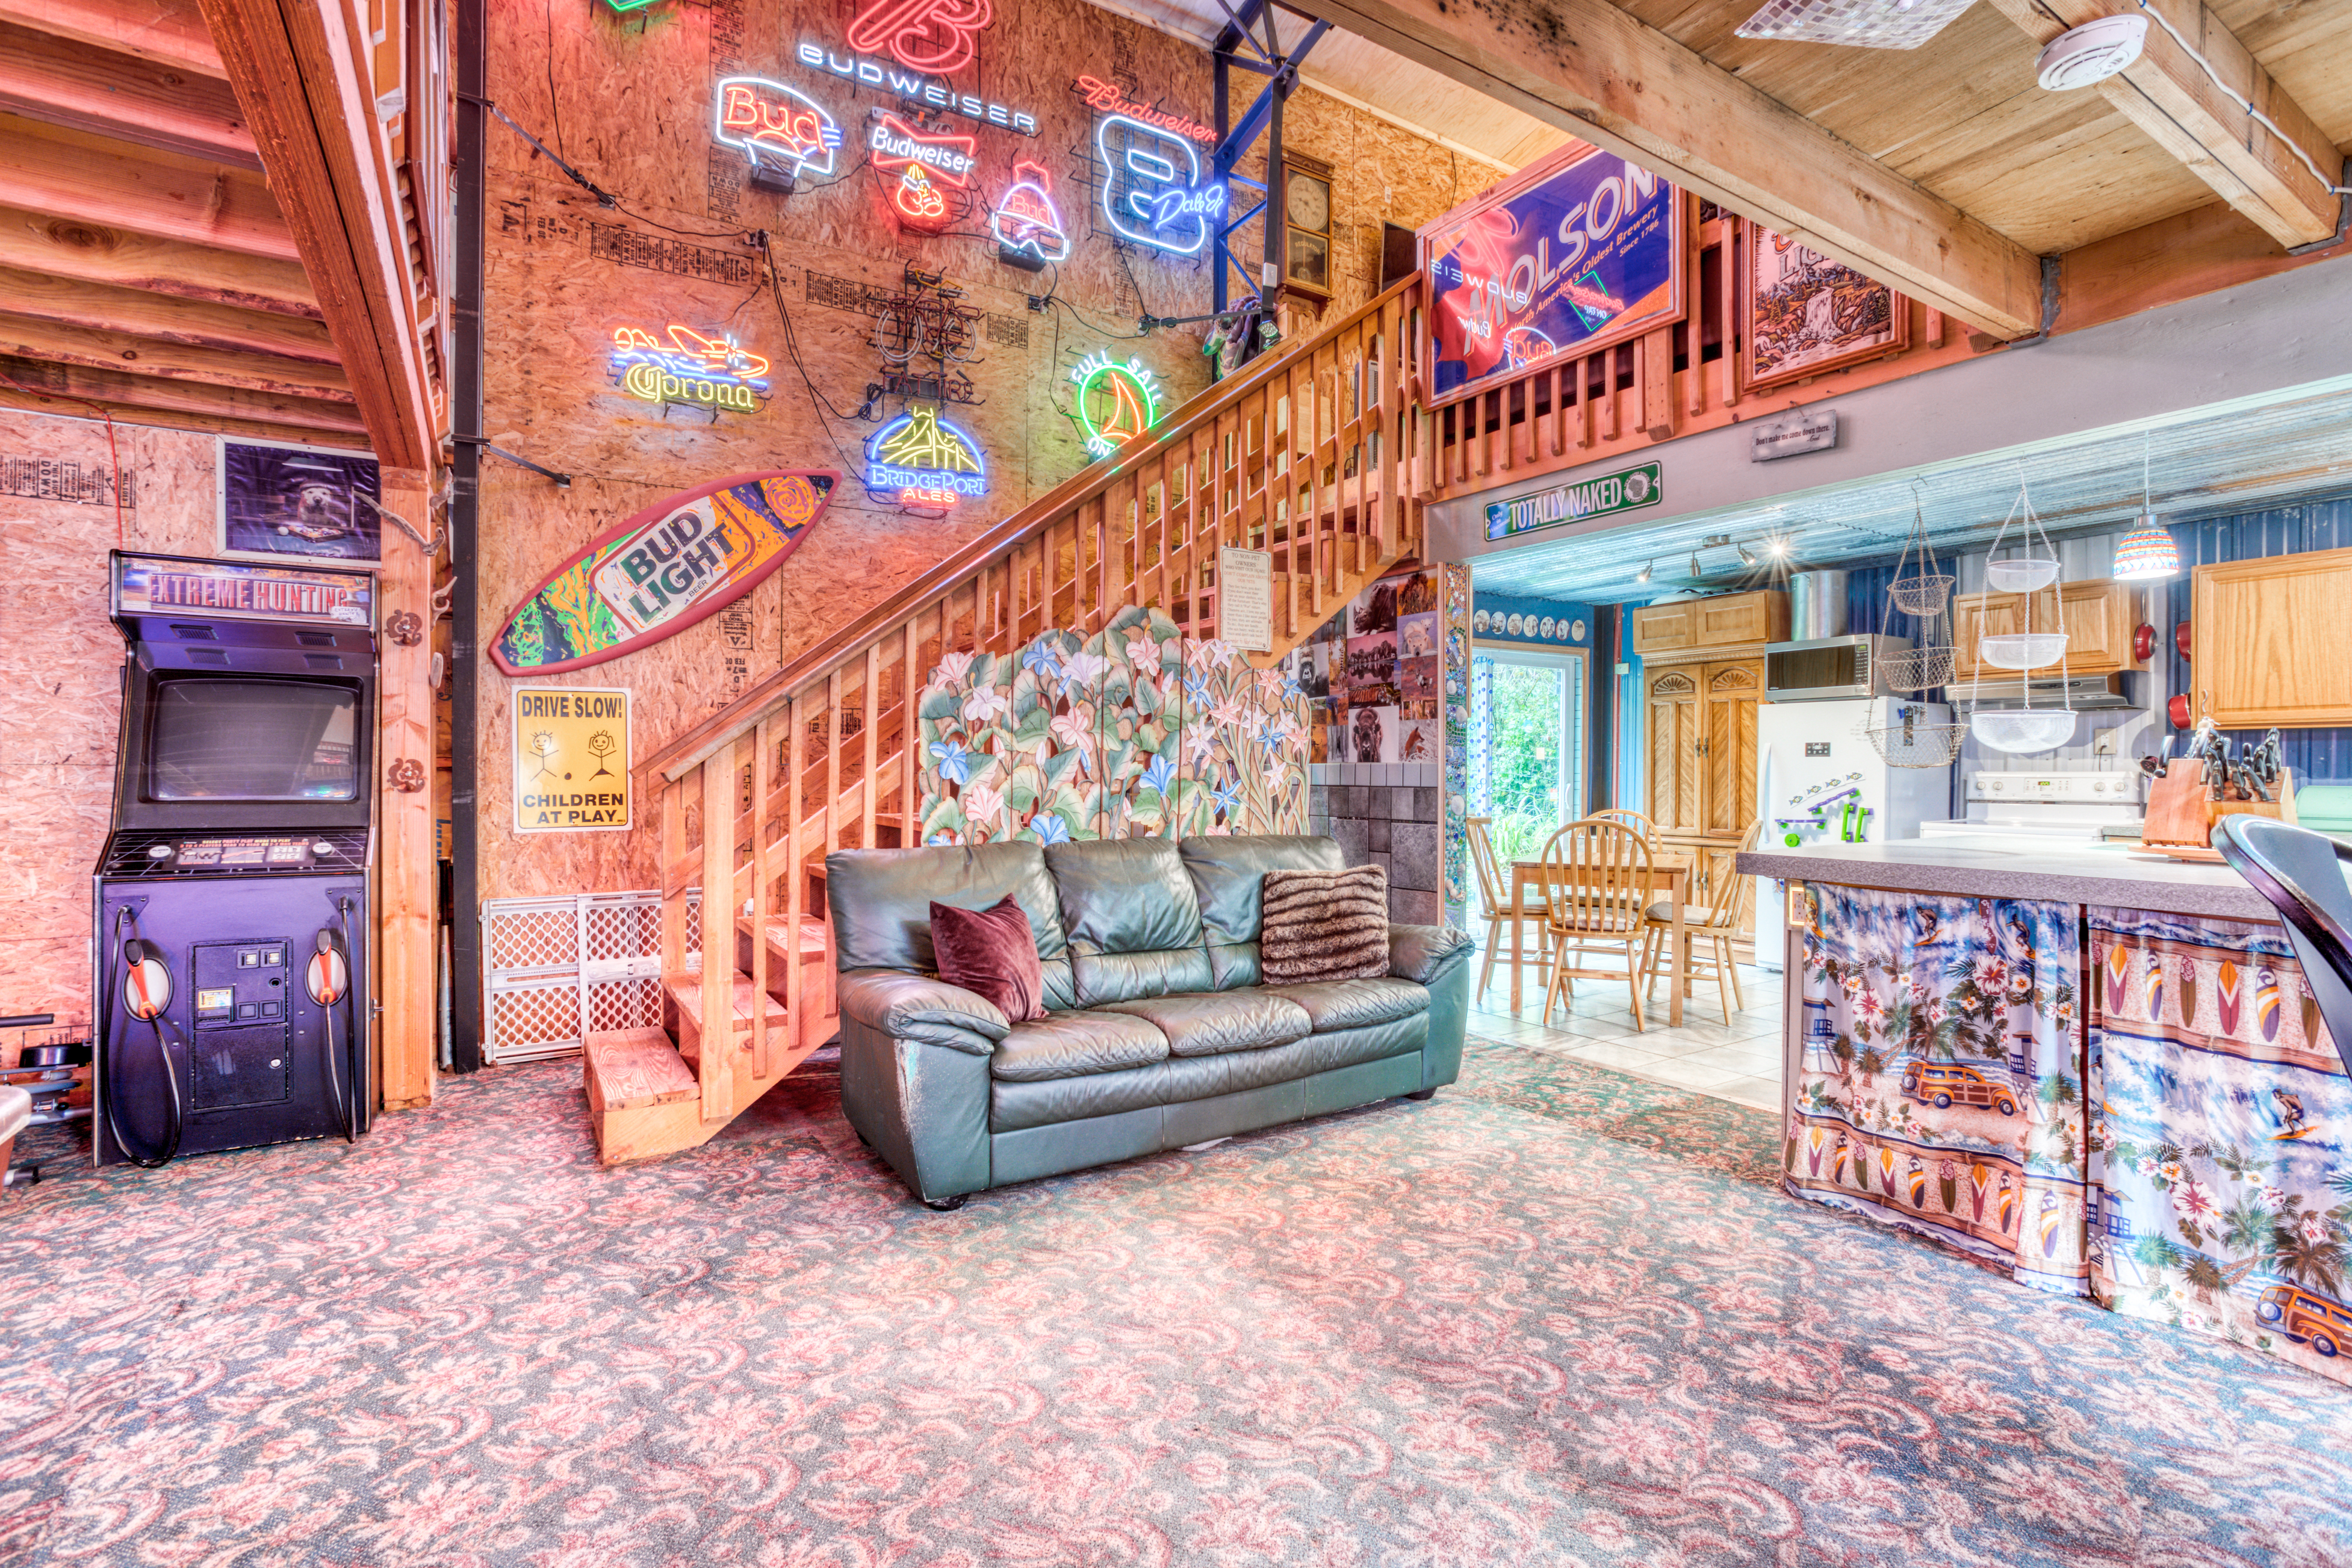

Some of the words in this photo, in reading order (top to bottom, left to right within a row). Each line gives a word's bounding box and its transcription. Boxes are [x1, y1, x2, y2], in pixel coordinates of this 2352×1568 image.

[799, 43, 1035, 133] BUDWEISER
[723, 86, 827, 153] Bud
[1078, 74, 1218, 142] Budweiser
[872, 125, 975, 173] Budweiser
[712, 175, 740, 187] DOWN
[1008, 193, 1053, 226] Bud
[1295, 241, 1321, 255] REGULATOR
[1620, 237, 1639, 257] Since
[1641, 218, 1659, 238] 1786
[1463, 161, 1657, 357] MOLSON
[1509, 309, 1535, 336] North
[1536, 271, 1580, 315] America's
[1582, 241, 1613, 274] Oldest
[1616, 204, 1659, 246] Brewery
[1778, 244, 1830, 282] LIG
[626, 362, 754, 408] Corona
[1071, 350, 1113, 386] FULL
[1126, 358, 1162, 406] SAIL
[1756, 437, 1768, 446] Don't
[1768, 434, 1780, 443] make
[1789, 430, 1801, 439] come
[1816, 425, 1829, 433] there.
[40, 460, 51, 495] DOWN
[903, 488, 955, 503] ALES
[1492, 510, 1503, 520] Only
[1509, 490, 1566, 530] TOTALLY
[1569, 477, 1622, 517] NAKED
[132, 563, 163, 572] Sammy
[619, 512, 703, 586] BUD
[628, 521, 734, 624] LIGHT
[688, 579, 709, 598] BEER
[148, 575, 250, 609] EXTREME
[253, 580, 347, 613] HUNTING
[522, 696, 570, 717] DRIVE
[574, 696, 623, 719] SLOW!
[523, 793, 624, 808] CHILDREN
[537, 811, 562, 824] AT
[568, 810, 617, 823] PLAY
